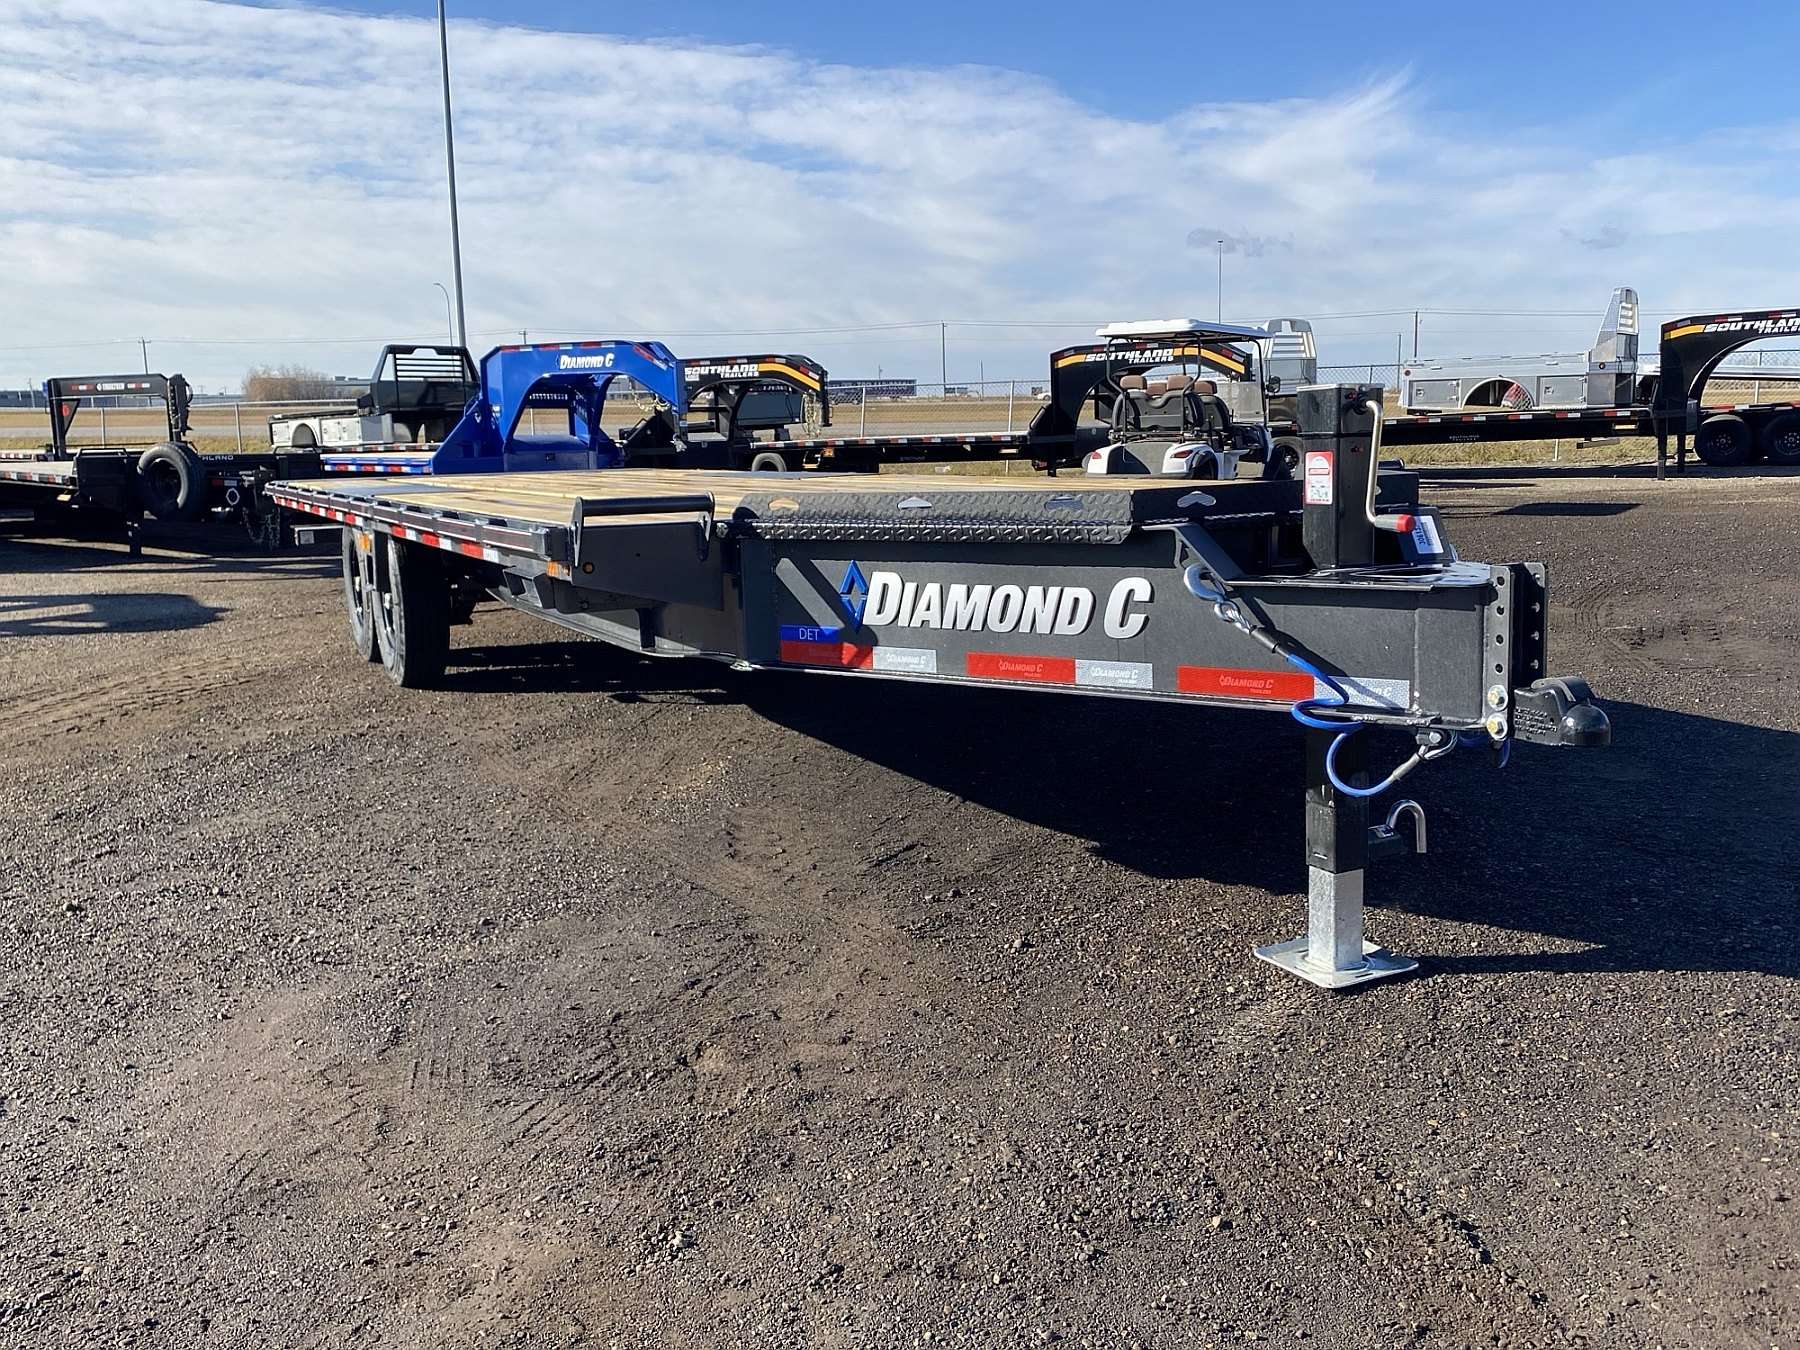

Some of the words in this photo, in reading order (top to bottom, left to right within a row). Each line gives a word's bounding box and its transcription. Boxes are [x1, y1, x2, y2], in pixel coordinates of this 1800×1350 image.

[1704, 317, 1800, 332] SOUTHLAN
[1758, 326, 1800, 334] TRAILE
[560, 354, 604, 370] DIAMOND
[605, 352, 615, 368] C
[685, 363, 758, 375] SOUTHLAND
[862, 571, 1095, 636] DIAMOND
[1103, 577, 1153, 639] C
[799, 627, 820, 641] DET
[1224, 675, 1265, 689] DIAMOND
